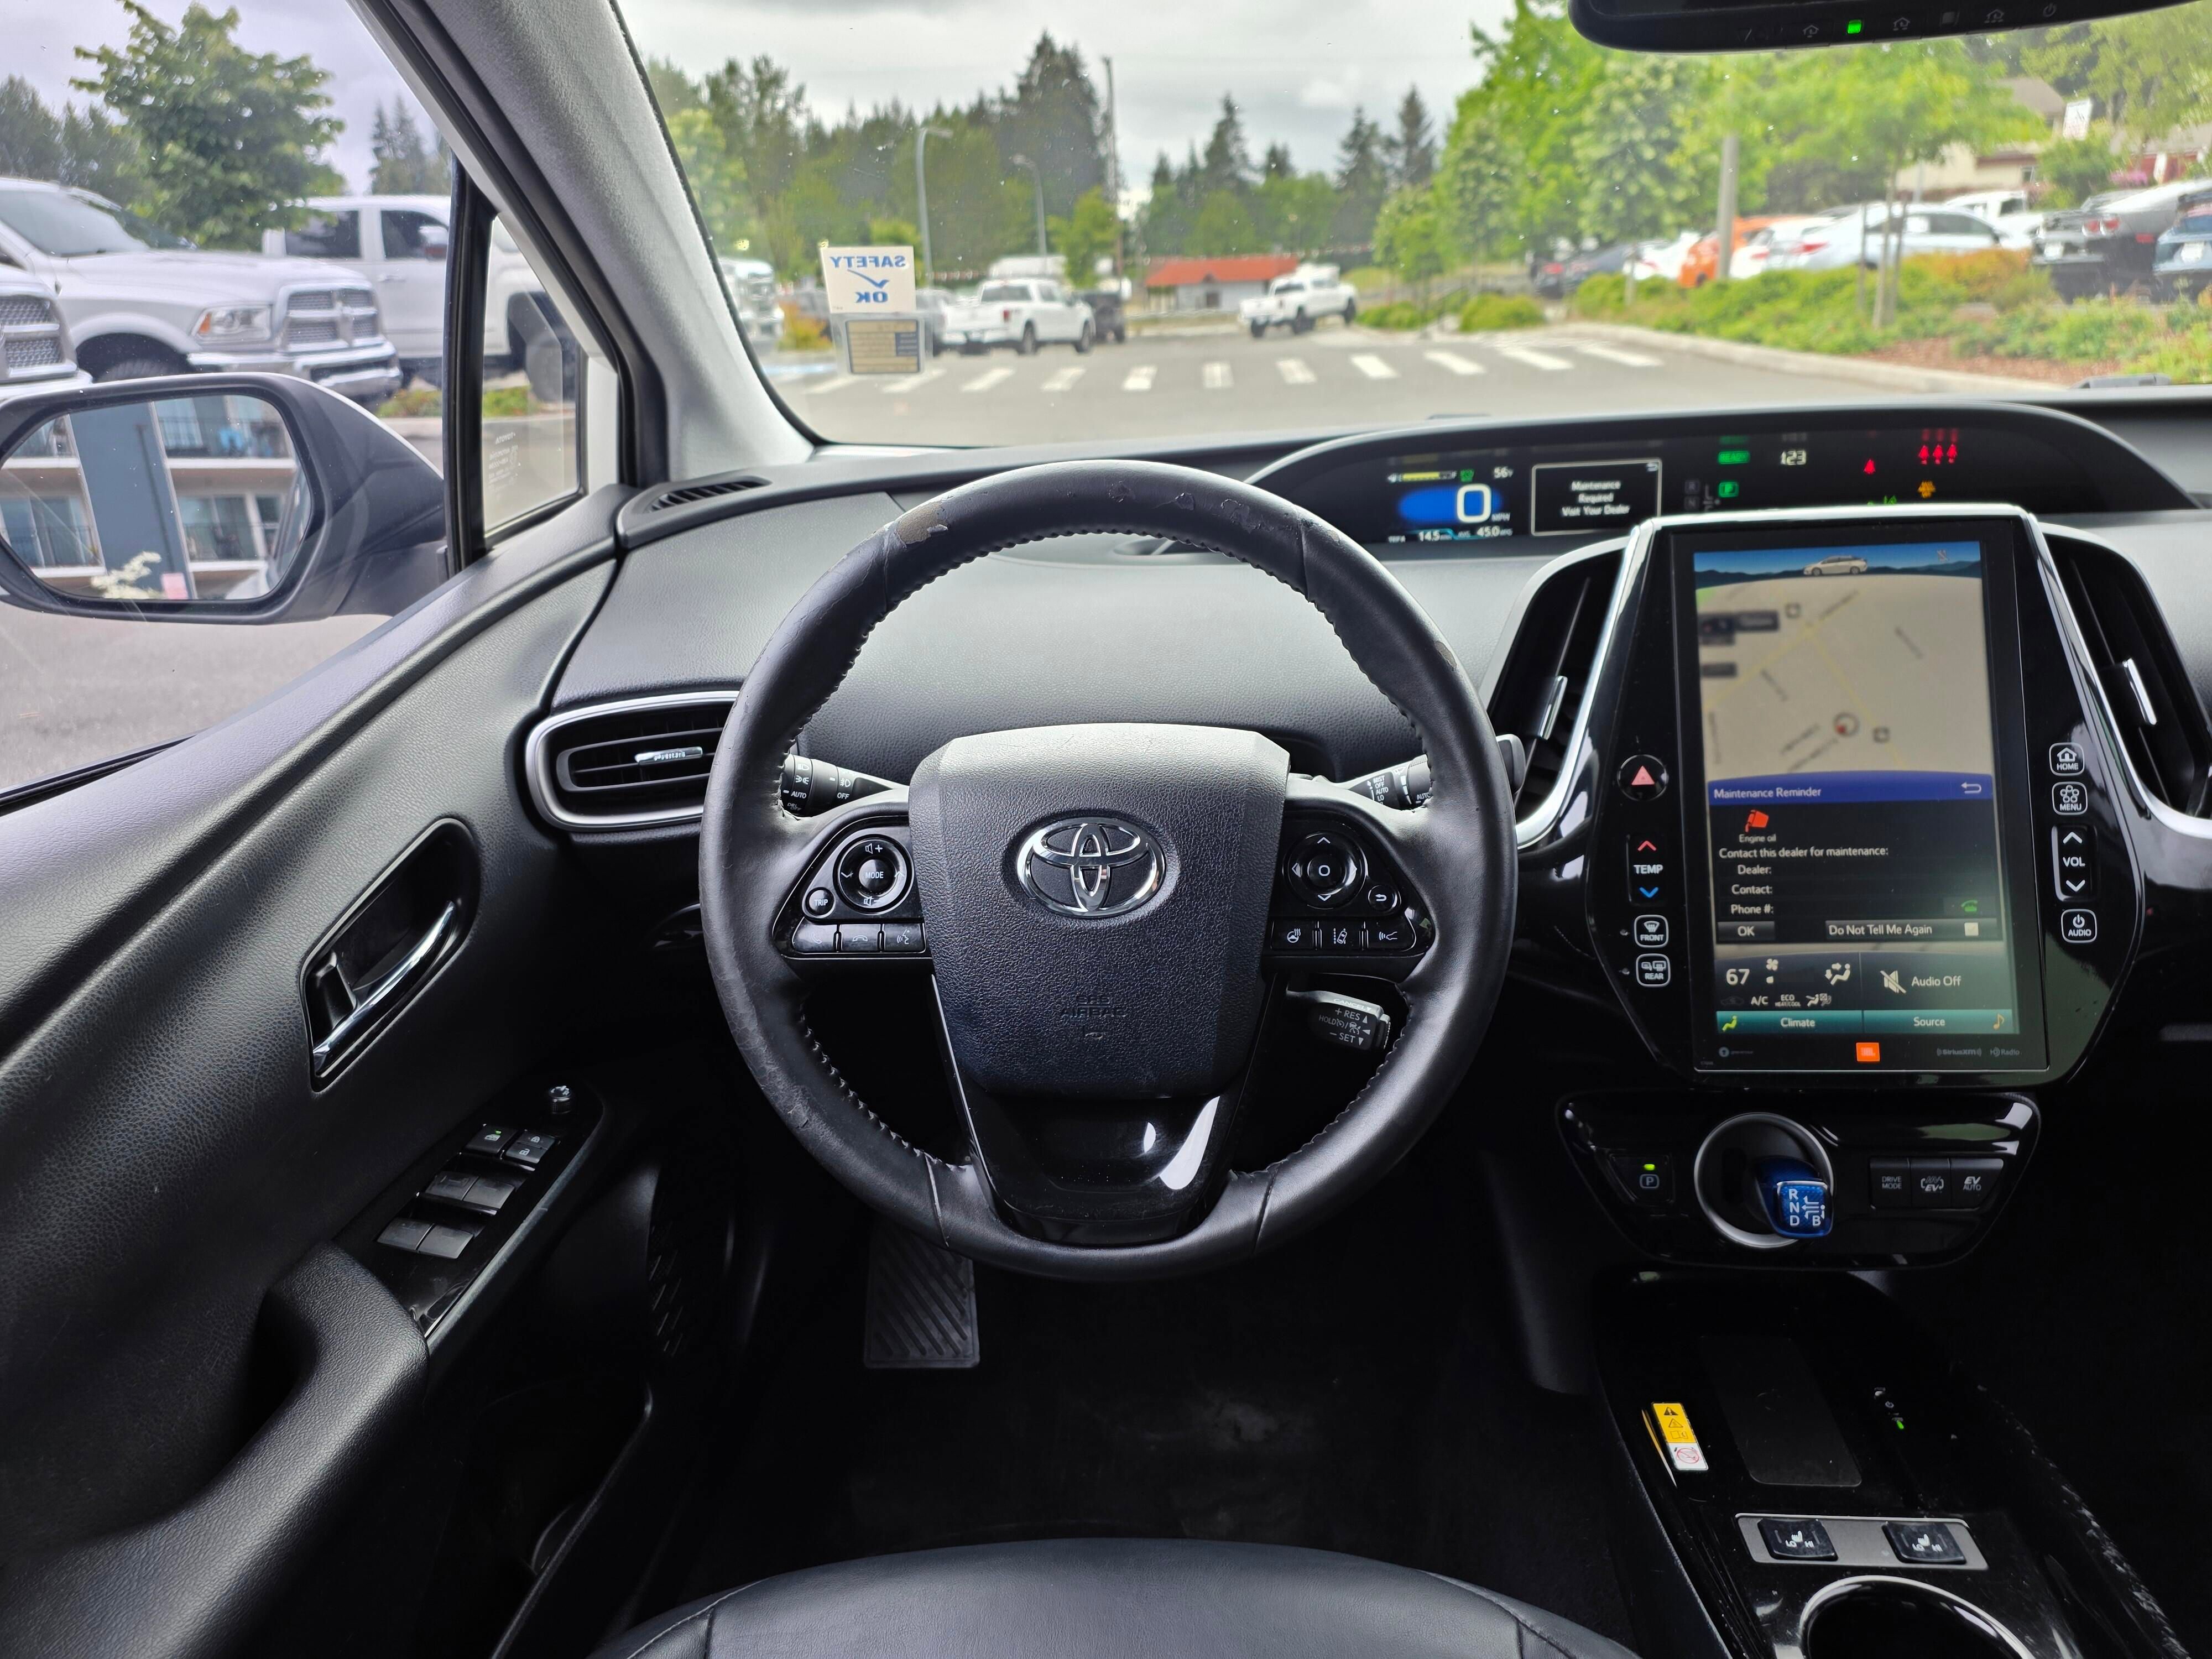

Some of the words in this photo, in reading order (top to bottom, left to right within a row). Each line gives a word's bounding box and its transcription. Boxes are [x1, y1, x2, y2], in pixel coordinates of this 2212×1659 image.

[1781, 450, 1807, 466] 123
[1572, 480, 1621, 491] Maintenance
[1457, 483, 1491, 523] 0
[1578, 492, 1614, 504] Required
[1562, 506, 1581, 516] Visit
[1583, 506, 1602, 515] Your
[1604, 504, 1630, 515] Dealer
[2057, 763, 2079, 771] HOME
[1373, 775, 1385, 784] MIST
[1376, 787, 1389, 795] AUTO
[1714, 789, 1773, 799] Maintenance
[1776, 787, 1822, 797] Reminder
[2059, 804, 2082, 812] MENU
[1739, 834, 1765, 844] Engine
[1767, 834, 1777, 842] oil
[1719, 848, 1757, 859] Contact
[1759, 848, 1777, 857] this
[1778, 847, 1808, 857] dealer
[1809, 846, 1824, 857] for
[1826, 847, 1888, 857] maintenance:
[2063, 857, 2085, 867] VOL
[1634, 864, 1663, 875] TEMP
[1738, 864, 1772, 874] Dealer:
[1731, 884, 1773, 894] Contact:
[1731, 904, 1761, 914] Phone
[1764, 904, 1774, 914] #:
[1738, 926, 1755, 936] OK
[1829, 925, 1844, 935] Do
[1846, 925, 1865, 935] Not
[1866, 924, 1884, 935] Tell
[1886, 924, 1902, 935] Me
[1905, 924, 1932, 936] Again
[2068, 929, 2092, 937] AUDIO
[1726, 968, 1750, 985] 67
[1911, 975, 1940, 987] Audio
[1943, 975, 1961, 986] Off
[1333, 998, 1365, 1011] CANCEL
[1751, 995, 1768, 1006] A/C
[1319, 1015, 1337, 1025] HOLD
[1344, 1010, 1360, 1021] RES
[1781, 1017, 1815, 1027] Climate
[1913, 1016, 1945, 1027] Source
[1339, 1032, 1355, 1044] SET
[1646, 1176, 1654, 1186] P
[1788, 1188, 1798, 1199] R
[1790, 1202, 1799, 1213] N
[1790, 1215, 1800, 1226] D
[1812, 1215, 1821, 1226] B
